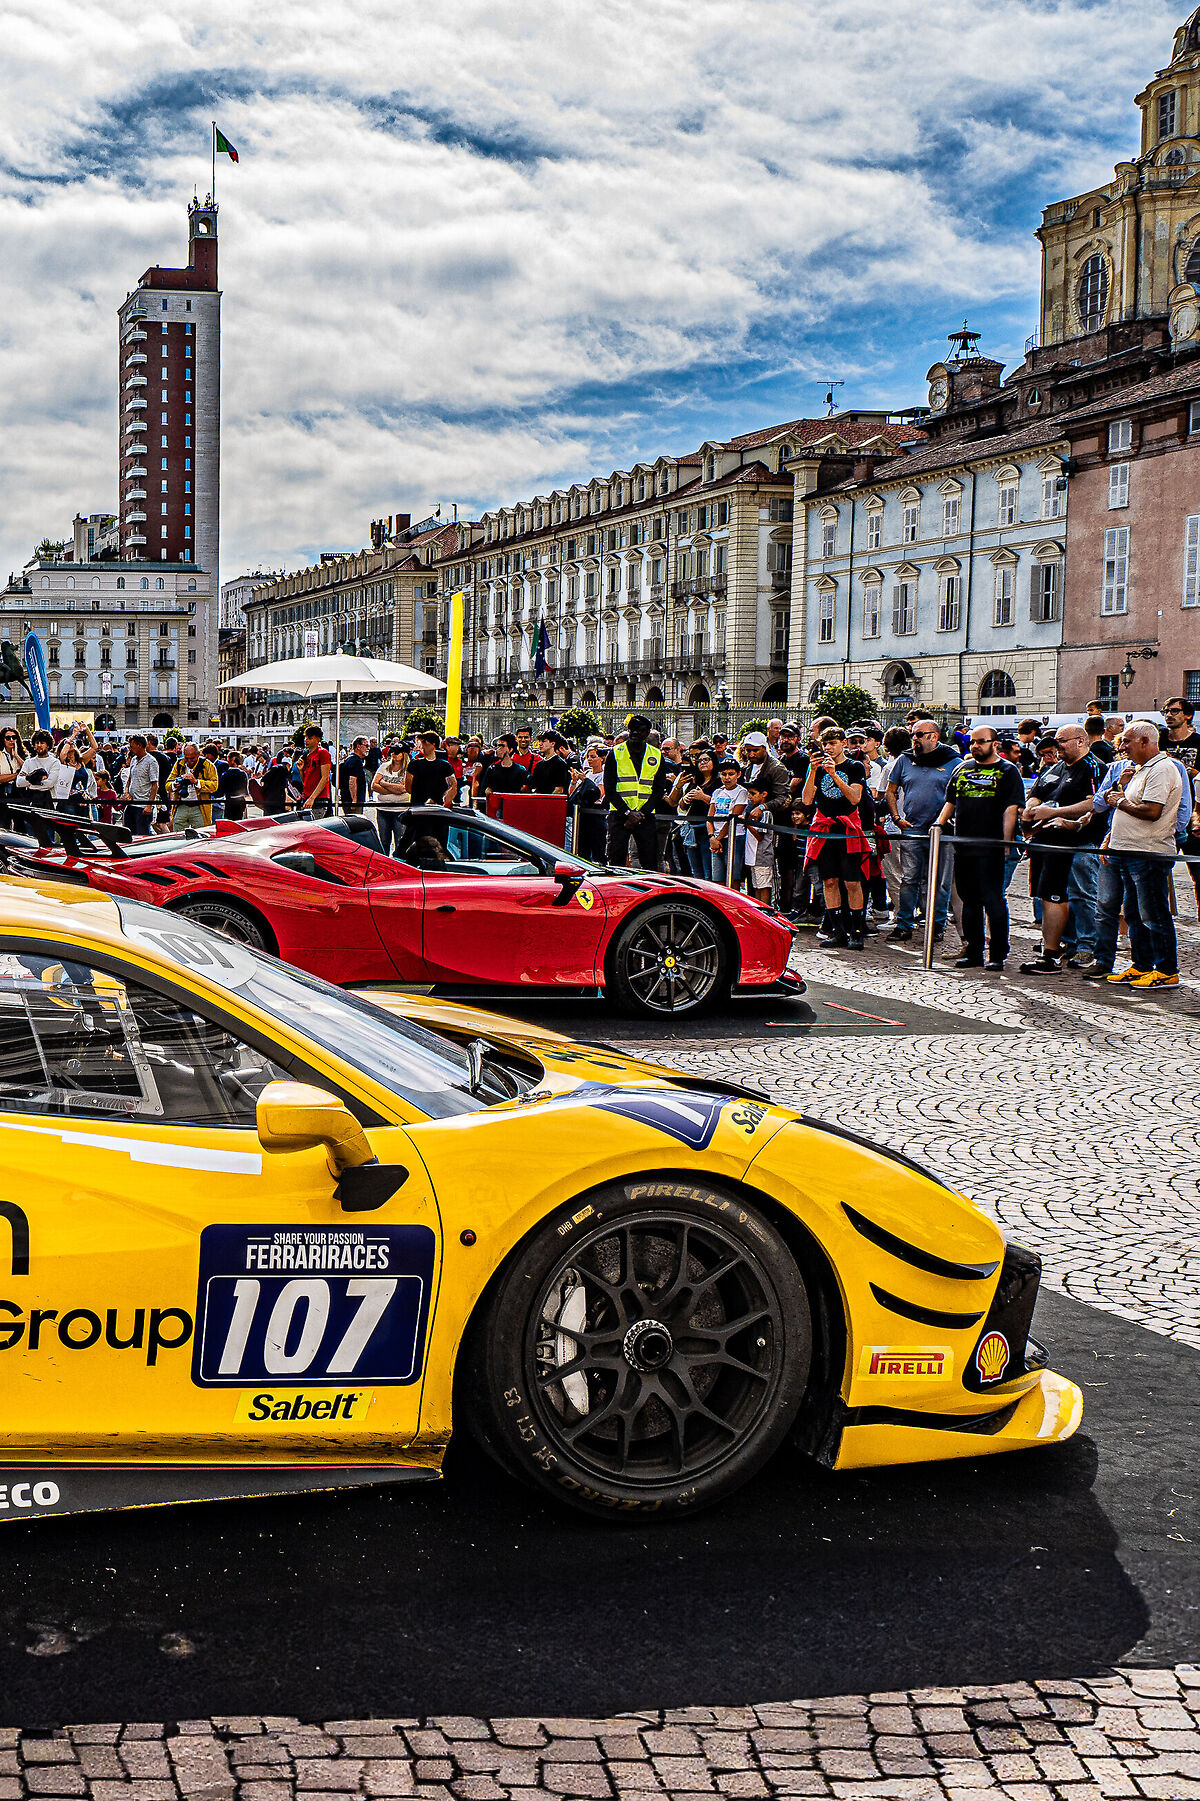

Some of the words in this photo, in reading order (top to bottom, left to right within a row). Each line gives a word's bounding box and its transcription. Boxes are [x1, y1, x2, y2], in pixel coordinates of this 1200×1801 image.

[204, 905, 242, 920] MICHELIN
[139, 932, 234, 969] 107
[630, 1184, 729, 1210] PIRELLI
[274, 1233, 301, 1245] SHARE
[303, 1233, 326, 1245] YOUR
[328, 1233, 364, 1245] PASSION
[246, 1245, 390, 1270] FERRARIRACES
[217, 1279, 398, 1374] 107
[869, 1353, 944, 1375] PIRELLI
[248, 1392, 358, 1421] Sabelt
